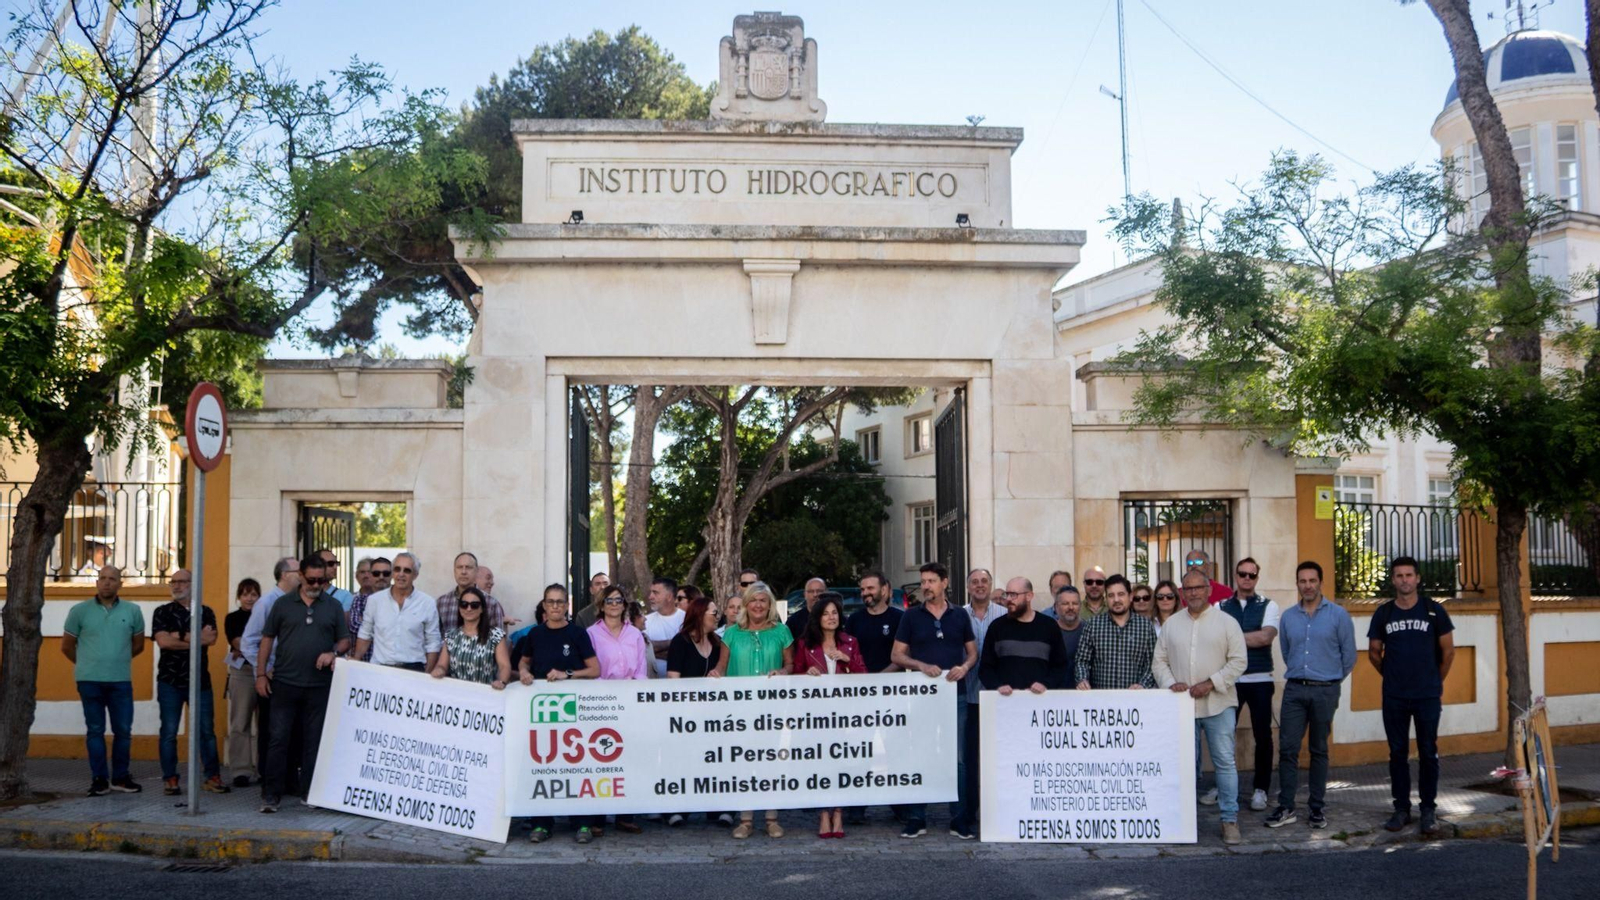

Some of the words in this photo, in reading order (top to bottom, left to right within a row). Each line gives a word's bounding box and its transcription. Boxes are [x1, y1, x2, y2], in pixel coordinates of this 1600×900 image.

[579, 167, 727, 194] INSTITUTO
[747, 170, 958, 198] HIDROGRAFICO
[1386, 620, 1430, 635] BOSTON
[578, 694, 617, 702] Federación
[637, 691, 655, 702] EN
[661, 690, 728, 702] DEFENSA
[734, 689, 752, 701] DE
[757, 688, 797, 700] UNOS
[801, 686, 877, 699] SALARIOS
[882, 684, 938, 696] DIGNOS
[348, 687, 371, 709] POR
[374, 692, 403, 716] UNOS
[406, 699, 460, 727] SALARIOS
[463, 710, 505, 735] DIGNOS
[578, 714, 618, 722] Ciudadanía
[669, 716, 697, 733] No
[704, 714, 747, 732] más
[753, 709, 907, 731] discriminación
[1031, 709, 1039, 727] A
[1043, 709, 1079, 727] IGUAL
[1083, 709, 1144, 729] TRABAJO,
[354, 728, 369, 743] NO
[370, 729, 388, 748] MÁS
[390, 735, 462, 763] DISCRIMINACIÓN
[464, 751, 488, 768] PARA
[530, 728, 624, 764] USO
[1041, 731, 1077, 749] IGUAL
[1082, 730, 1135, 748] SALARIO
[704, 747, 723, 763] al
[730, 743, 822, 763] Personal
[829, 742, 873, 759] Civil
[366, 748, 379, 764] EL
[379, 751, 425, 774] PERSONAL
[428, 760, 449, 777] CIVIL
[451, 765, 468, 782] DEL
[531, 767, 557, 775] UNIÓN
[1016, 763, 1030, 777] NO
[1033, 760, 1053, 777] MÁS
[1056, 759, 1133, 777] DISCRIMINACIÓN
[1136, 762, 1162, 777] PARA
[359, 764, 410, 787] MINISTERIO
[411, 774, 424, 790] DE
[426, 778, 467, 799] DEFENSA
[532, 777, 625, 799] APLAGE
[654, 778, 686, 795] del
[694, 774, 799, 794] Ministerio
[806, 773, 831, 789] de
[838, 771, 923, 788] Defensa
[1034, 780, 1045, 794] EL
[1048, 780, 1098, 794] PERSONAL
[1101, 779, 1124, 793] CIVIL
[1127, 779, 1145, 793] DEL
[343, 786, 392, 814] DEFENSA
[395, 796, 435, 822] SOMOS
[438, 804, 476, 830] TODOS
[1030, 797, 1085, 811] MINISTERIO
[1088, 797, 1100, 811] DE
[1103, 796, 1148, 811] DEFENSA
[1019, 819, 1071, 839] DEFENSA
[1076, 819, 1117, 839] SOMOS
[1121, 819, 1161, 839] TODOS
